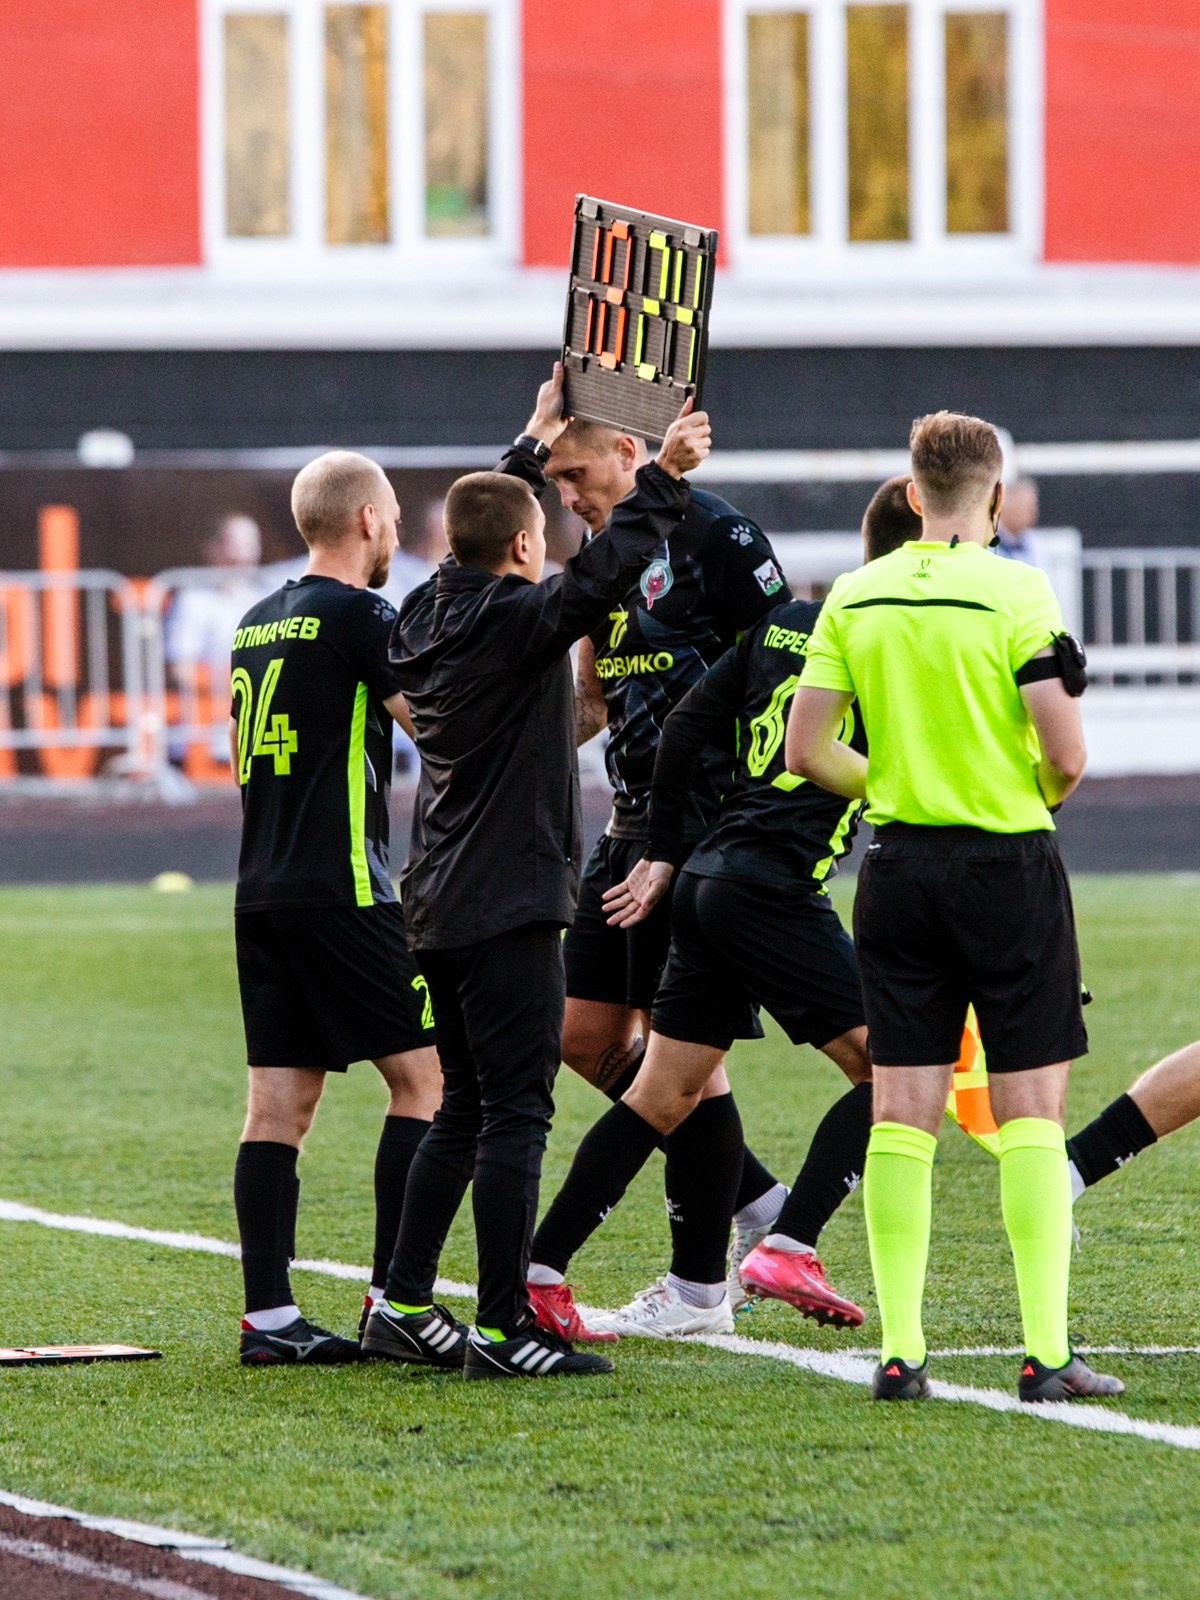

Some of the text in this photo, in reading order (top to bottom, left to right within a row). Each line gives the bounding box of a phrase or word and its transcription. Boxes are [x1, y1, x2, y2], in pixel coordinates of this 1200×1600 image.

[634, 231, 703, 382] 24
[232, 616, 321, 651] ОЛМАЧЕВ
[595, 651, 674, 680] ЕРВИКО
[232, 658, 298, 786] 24
